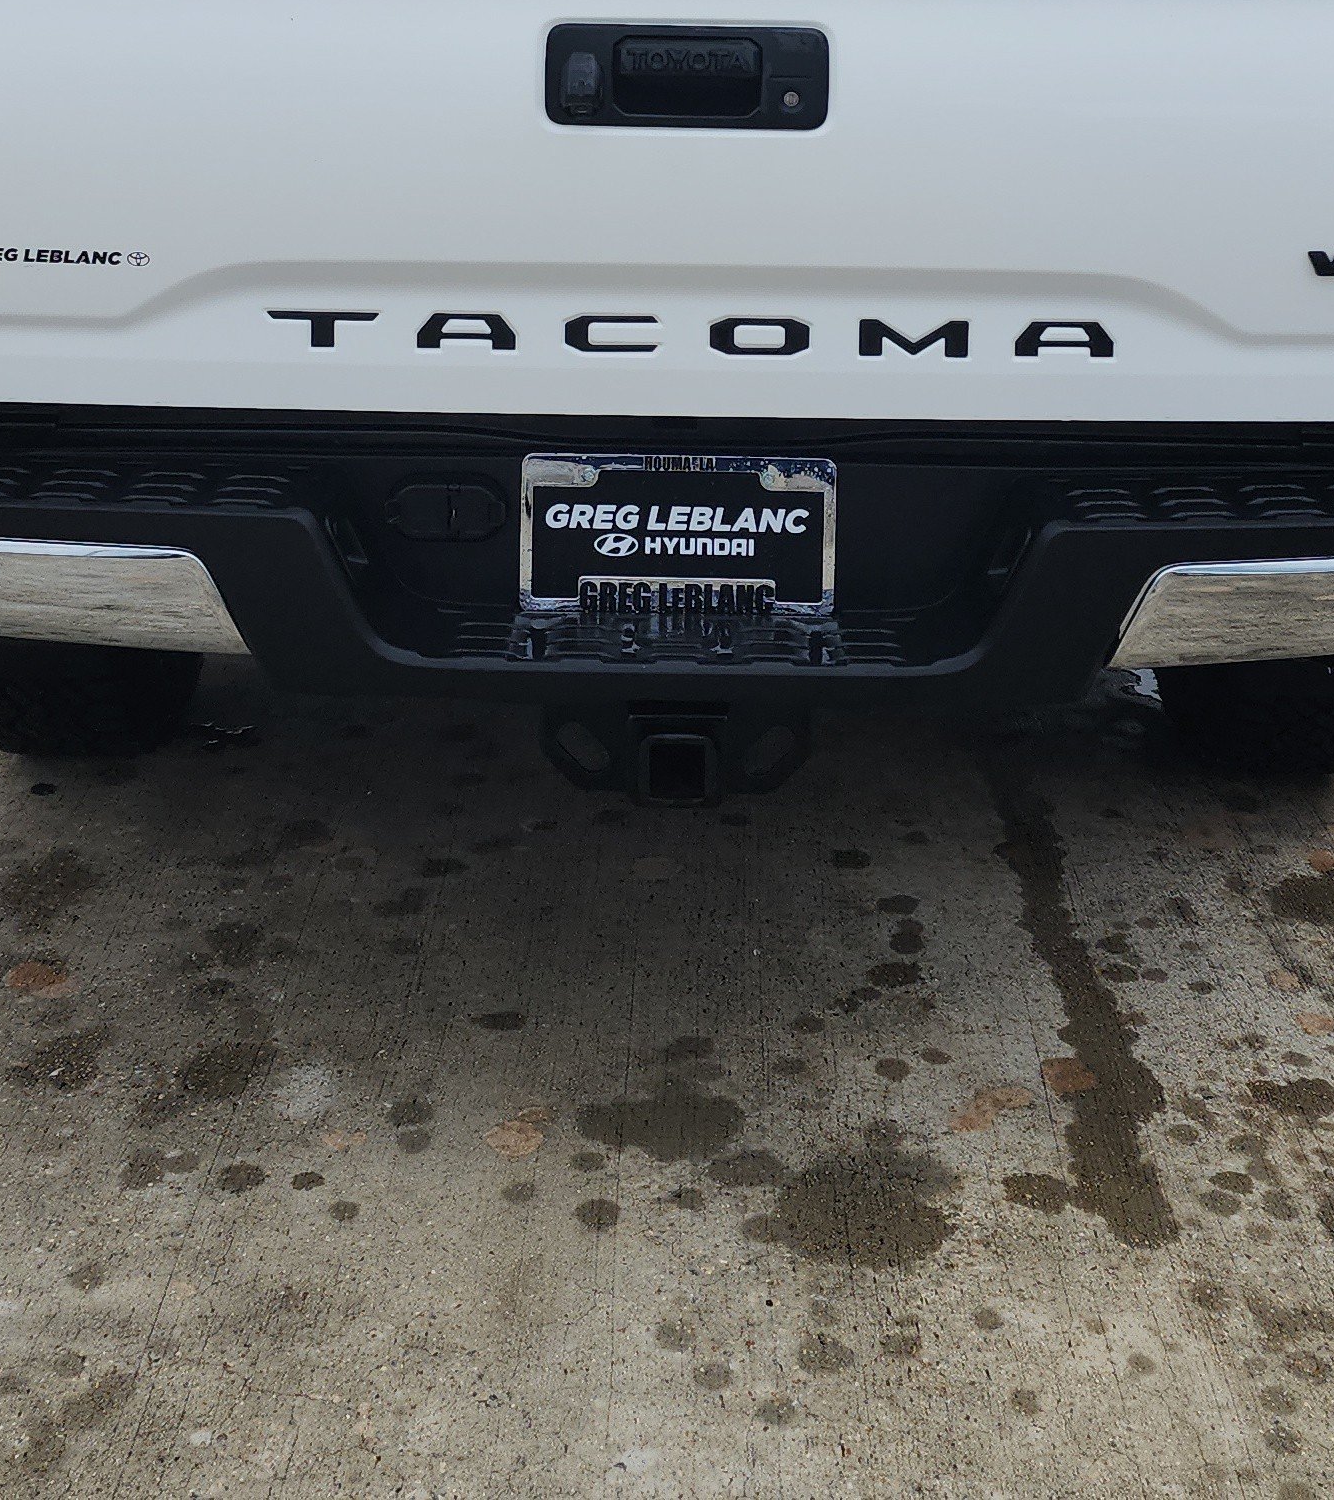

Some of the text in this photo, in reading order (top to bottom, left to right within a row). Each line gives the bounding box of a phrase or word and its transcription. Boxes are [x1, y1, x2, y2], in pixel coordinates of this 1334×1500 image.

[628, 49, 744, 71] TOYOTA
[22, 248, 123, 266] LEBLANC
[266, 309, 1116, 358] TACOMA
[545, 503, 810, 534] GREG LEBLANC
[645, 536, 755, 557] HYUNDAI
[579, 580, 651, 614] GREG
